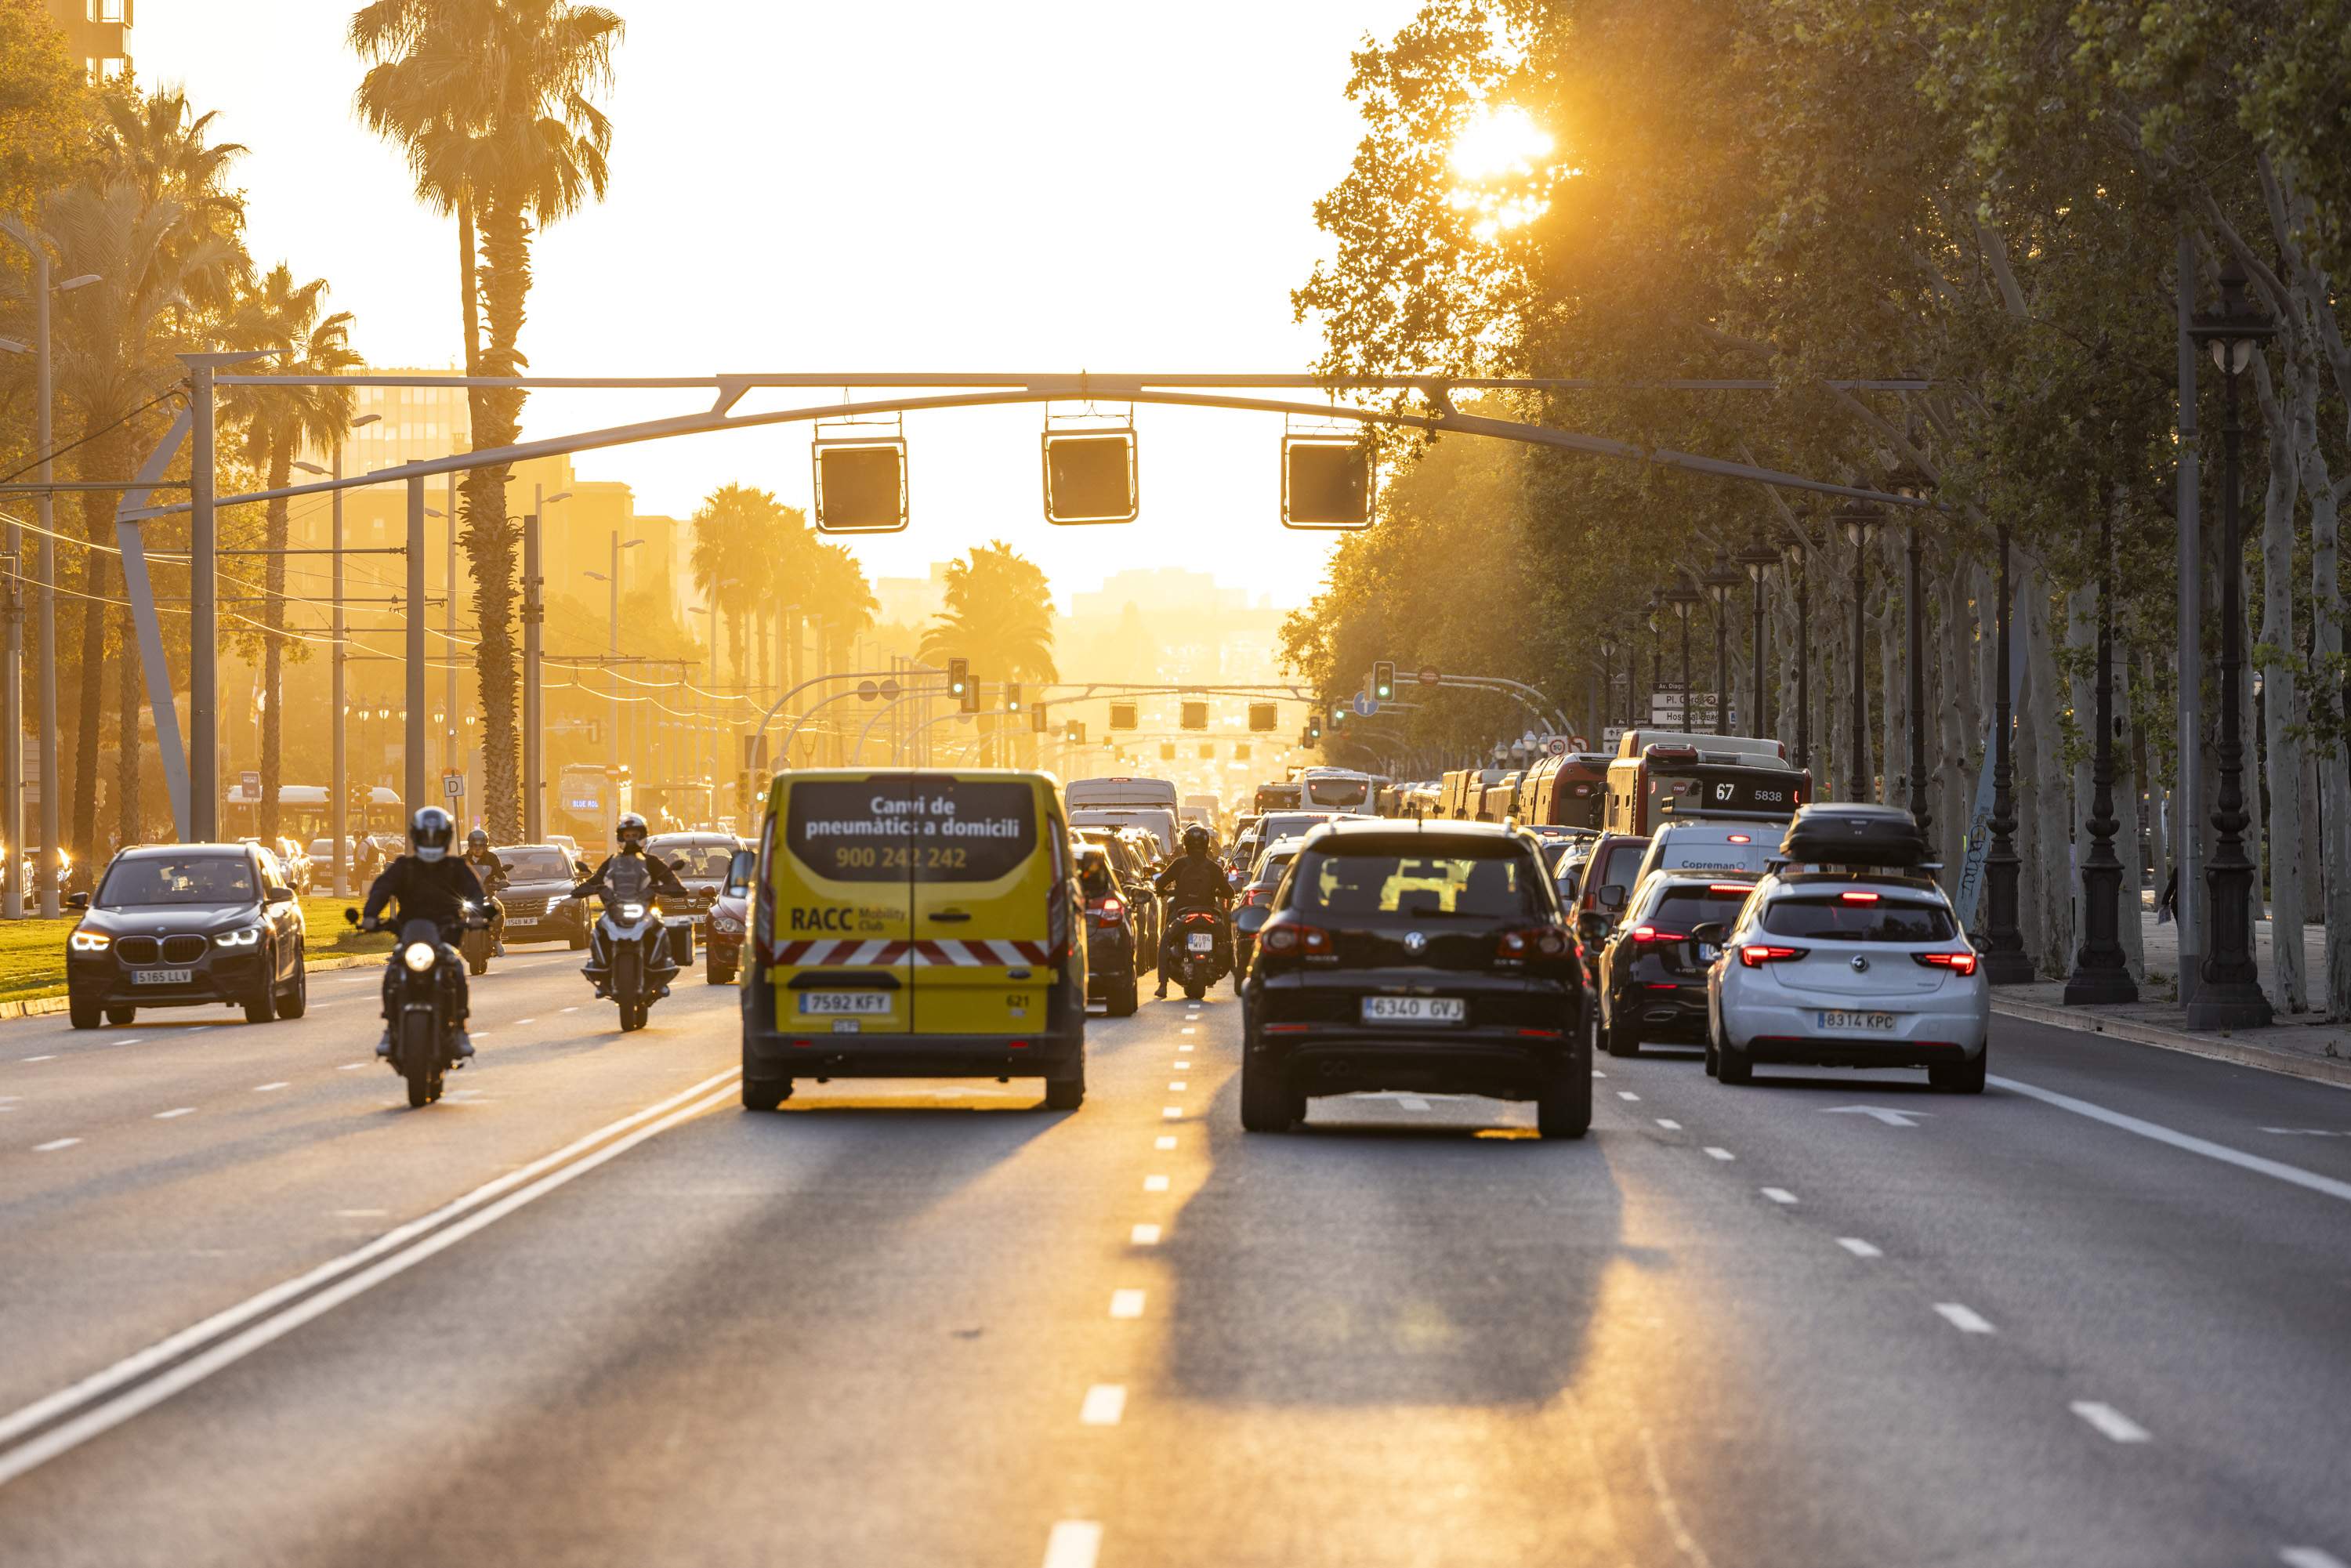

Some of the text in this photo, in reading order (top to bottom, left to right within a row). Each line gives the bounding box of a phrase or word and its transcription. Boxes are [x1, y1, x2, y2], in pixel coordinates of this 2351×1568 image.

[1666, 695, 1677, 704] Pl.
[448, 780, 458, 793] D
[1716, 784, 1782, 802] 67 5838
[870, 795, 956, 815] Canvi de
[923, 821, 937, 836] a
[941, 817, 1020, 838] domicili
[835, 847, 967, 868] 900 242 242
[1680, 860, 1735, 871] Copreman
[791, 907, 854, 931] RACC
[859, 907, 906, 922] Mobility
[858, 919, 884, 932] Club
[139, 971, 189, 983] 5165 LLV
[812, 994, 886, 1011] 7592 KFY
[1006, 994, 1029, 1008] 621
[1375, 1000, 1462, 1017] 6340 GVJ
[1827, 1013, 1894, 1030] 8314 KPC
